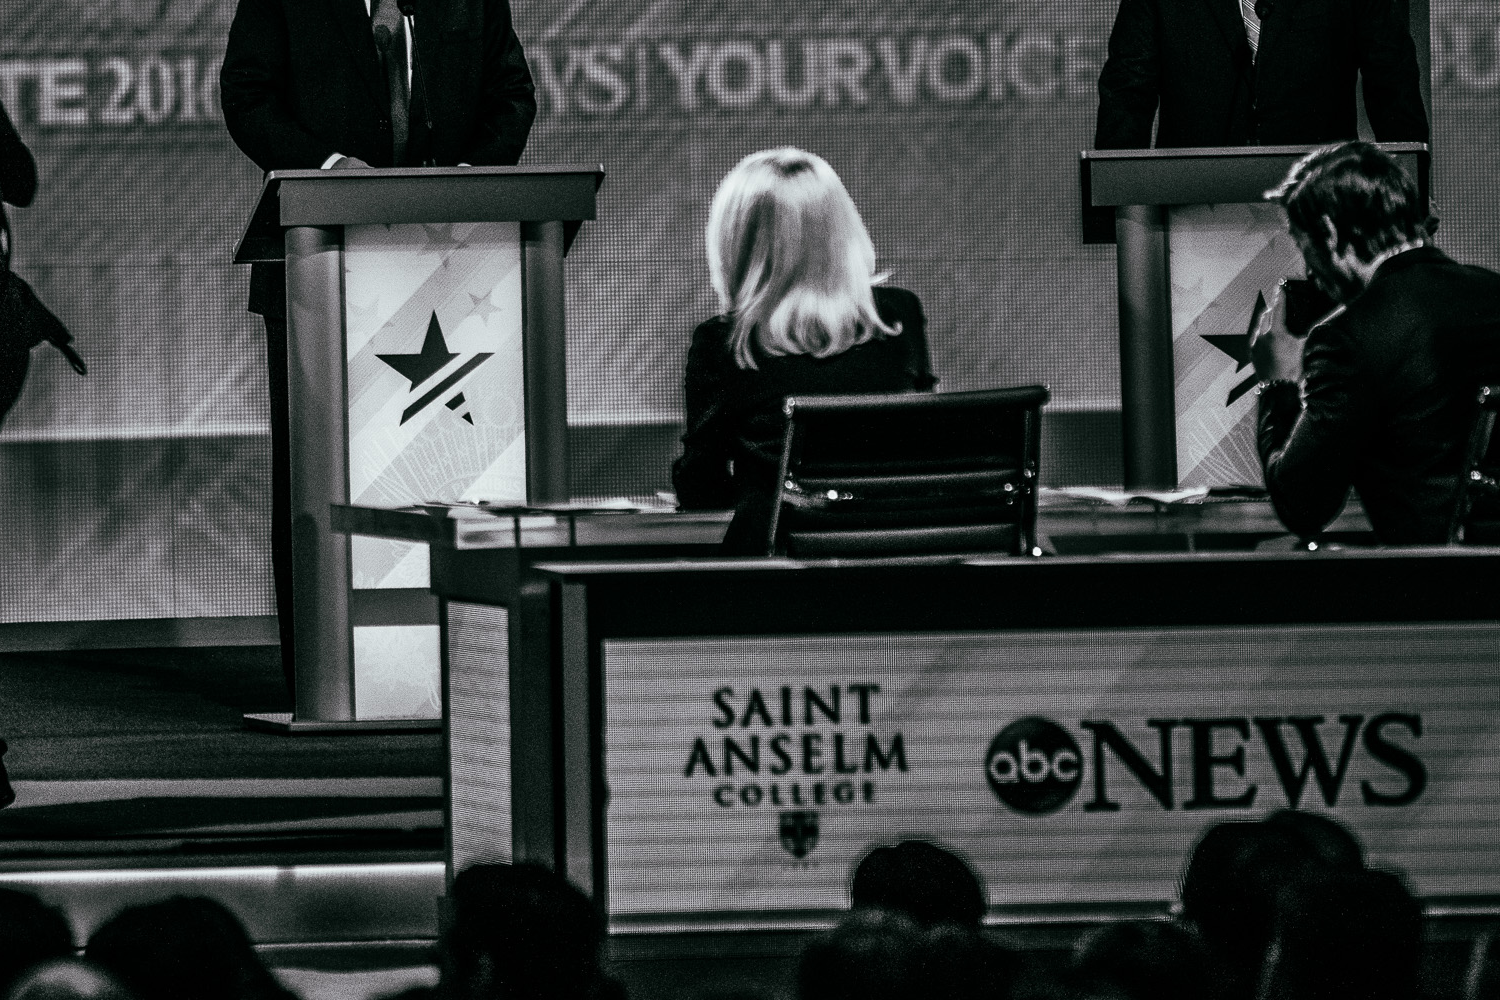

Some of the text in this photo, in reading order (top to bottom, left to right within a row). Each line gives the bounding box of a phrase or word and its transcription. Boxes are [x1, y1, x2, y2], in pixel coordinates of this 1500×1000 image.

[658, 40, 871, 110] YOUR
[875, 32, 1099, 105] VOICE
[711, 683, 881, 729] SAINT
[683, 732, 909, 778] ANSELM
[1083, 711, 1430, 813] NEWS
[712, 781, 877, 808] COLLEGE
